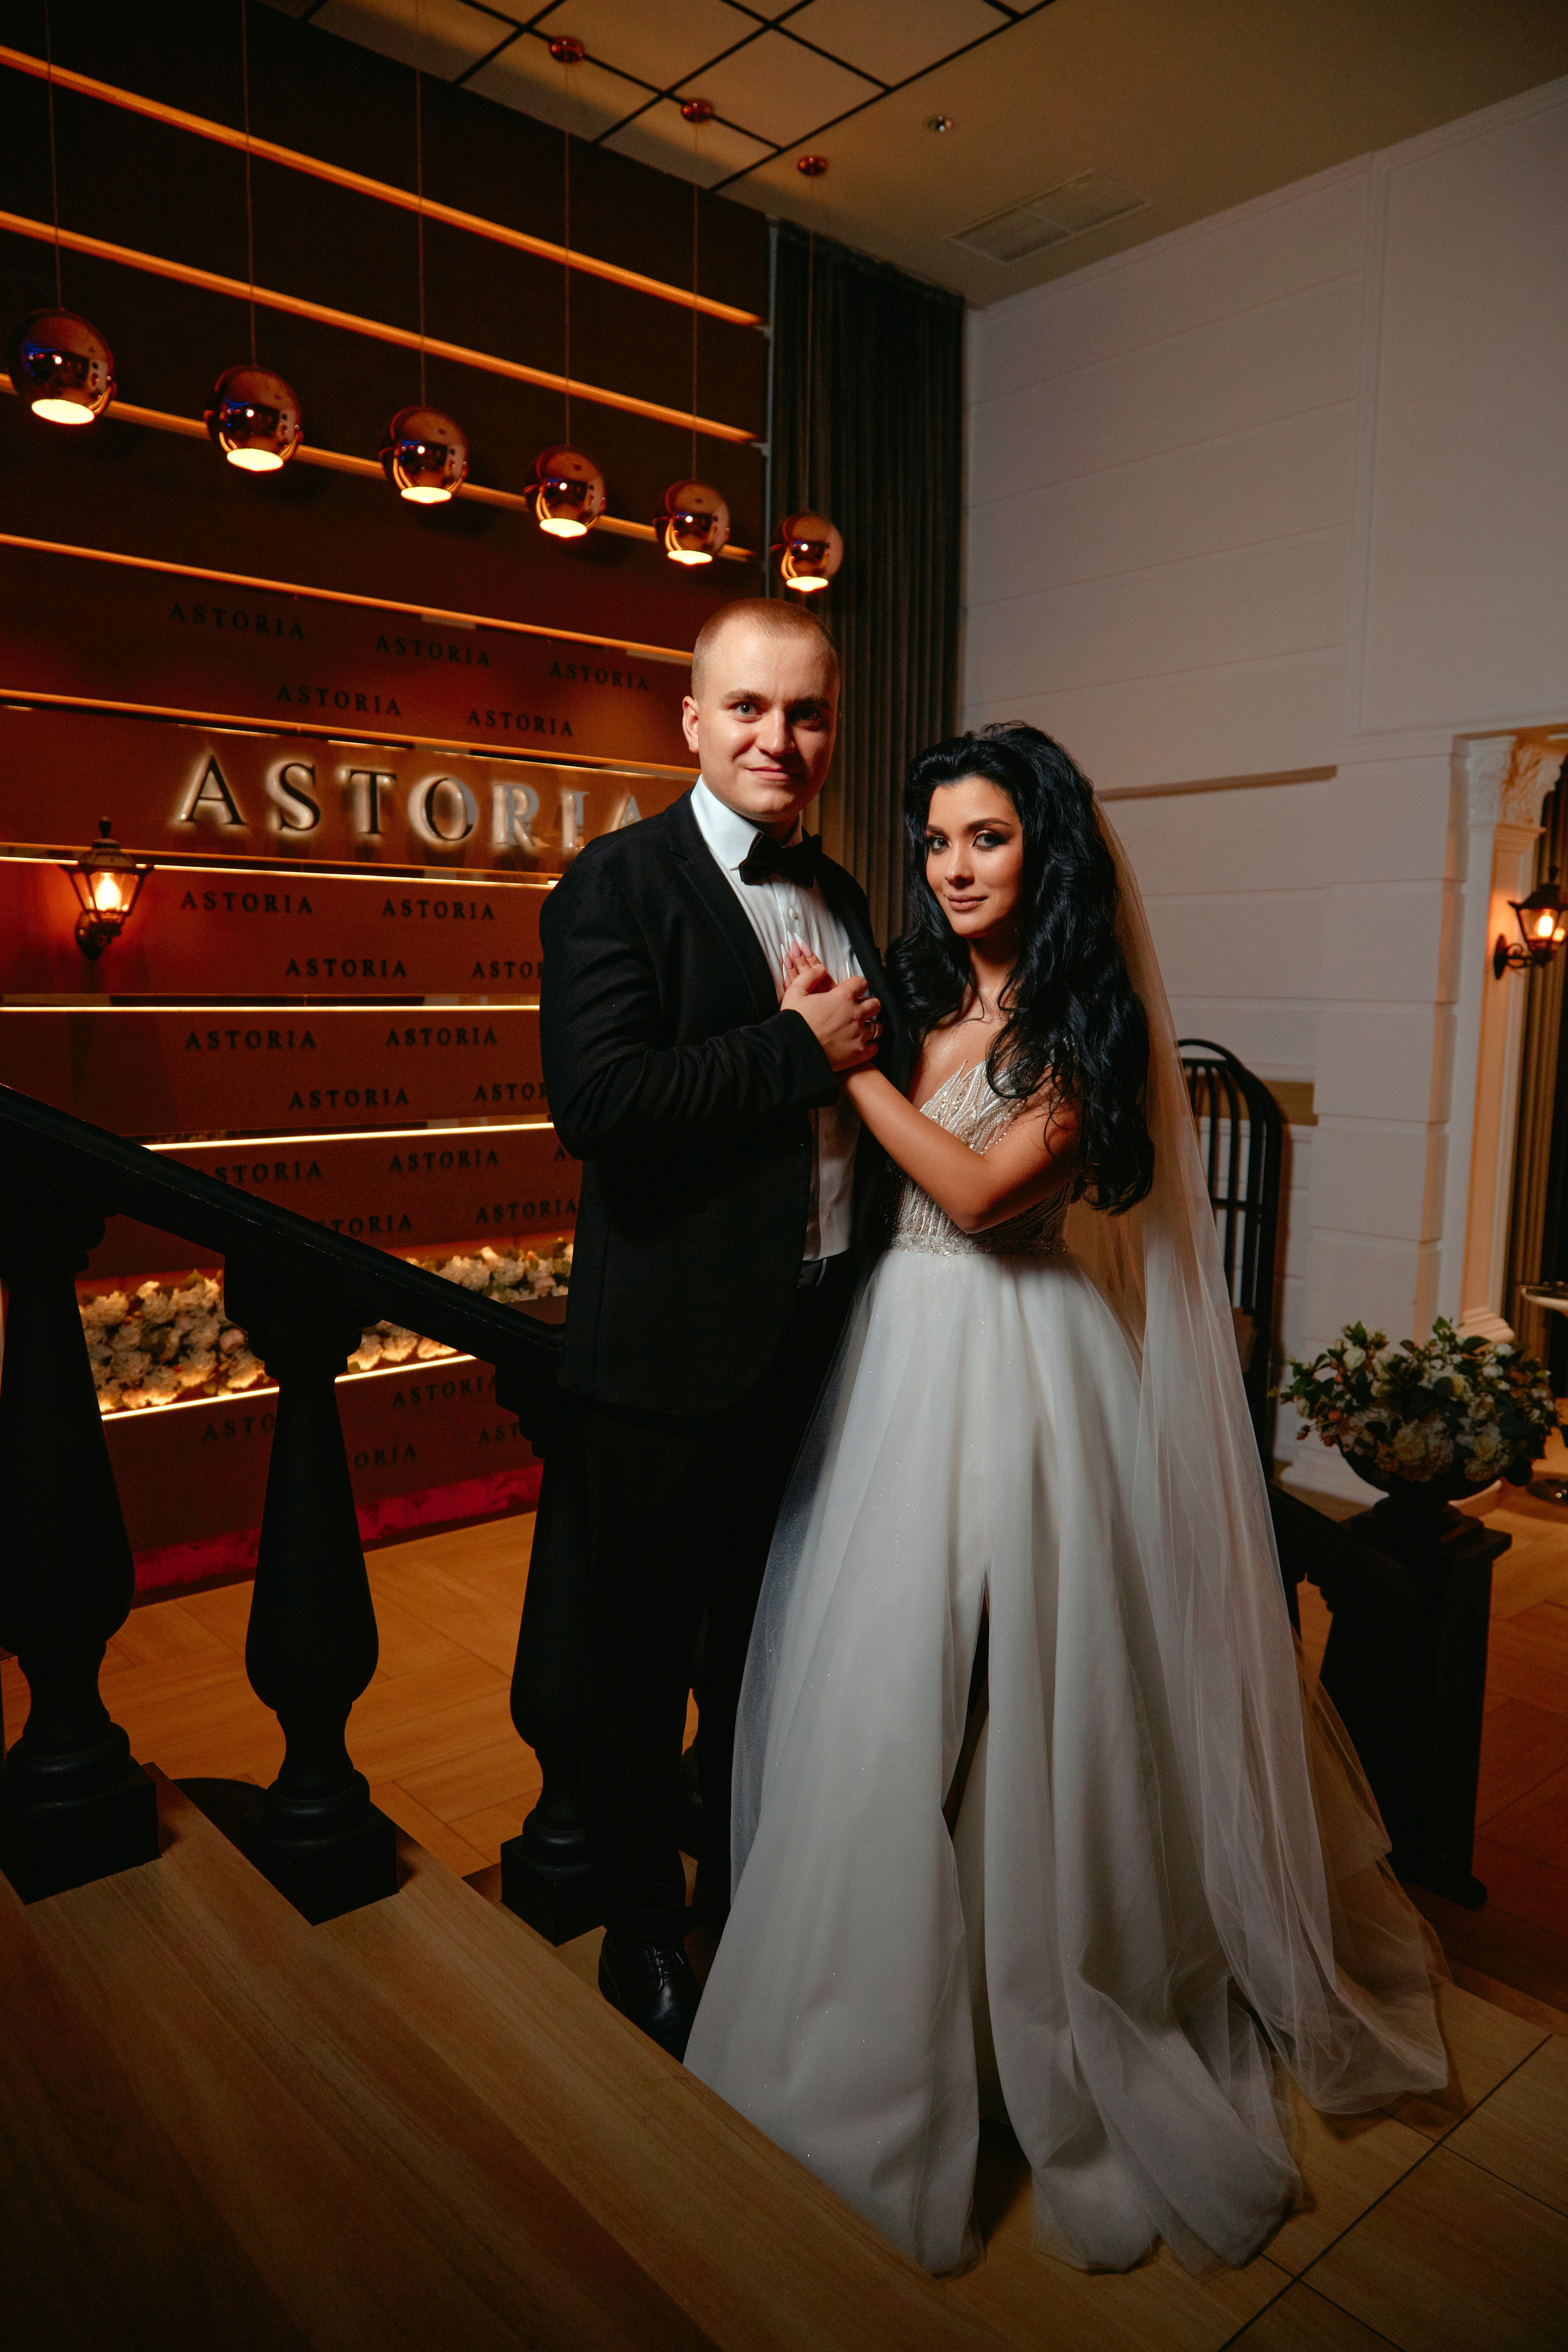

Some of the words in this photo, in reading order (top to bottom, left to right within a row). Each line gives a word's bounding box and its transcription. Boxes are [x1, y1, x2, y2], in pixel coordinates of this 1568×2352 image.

[169, 603, 304, 639] ASTORIA
[375, 635, 490, 666] ASTORIA
[549, 662, 649, 691] ASTORIA
[277, 685, 401, 715] ASTORIA
[468, 710, 573, 736] ASTORIA
[182, 891, 313, 914] ASTORIA
[382, 899, 494, 920] ASTORIA
[286, 959, 407, 978] ASTORIA
[186, 1030, 315, 1049] ASTORIA
[386, 1027, 497, 1046] ASTORIA
[290, 1088, 409, 1109] ASTORIA
[198, 1160, 322, 1183] STORIA
[390, 1150, 498, 1171] ASTORIA
[477, 1199, 577, 1223] ASTORIA
